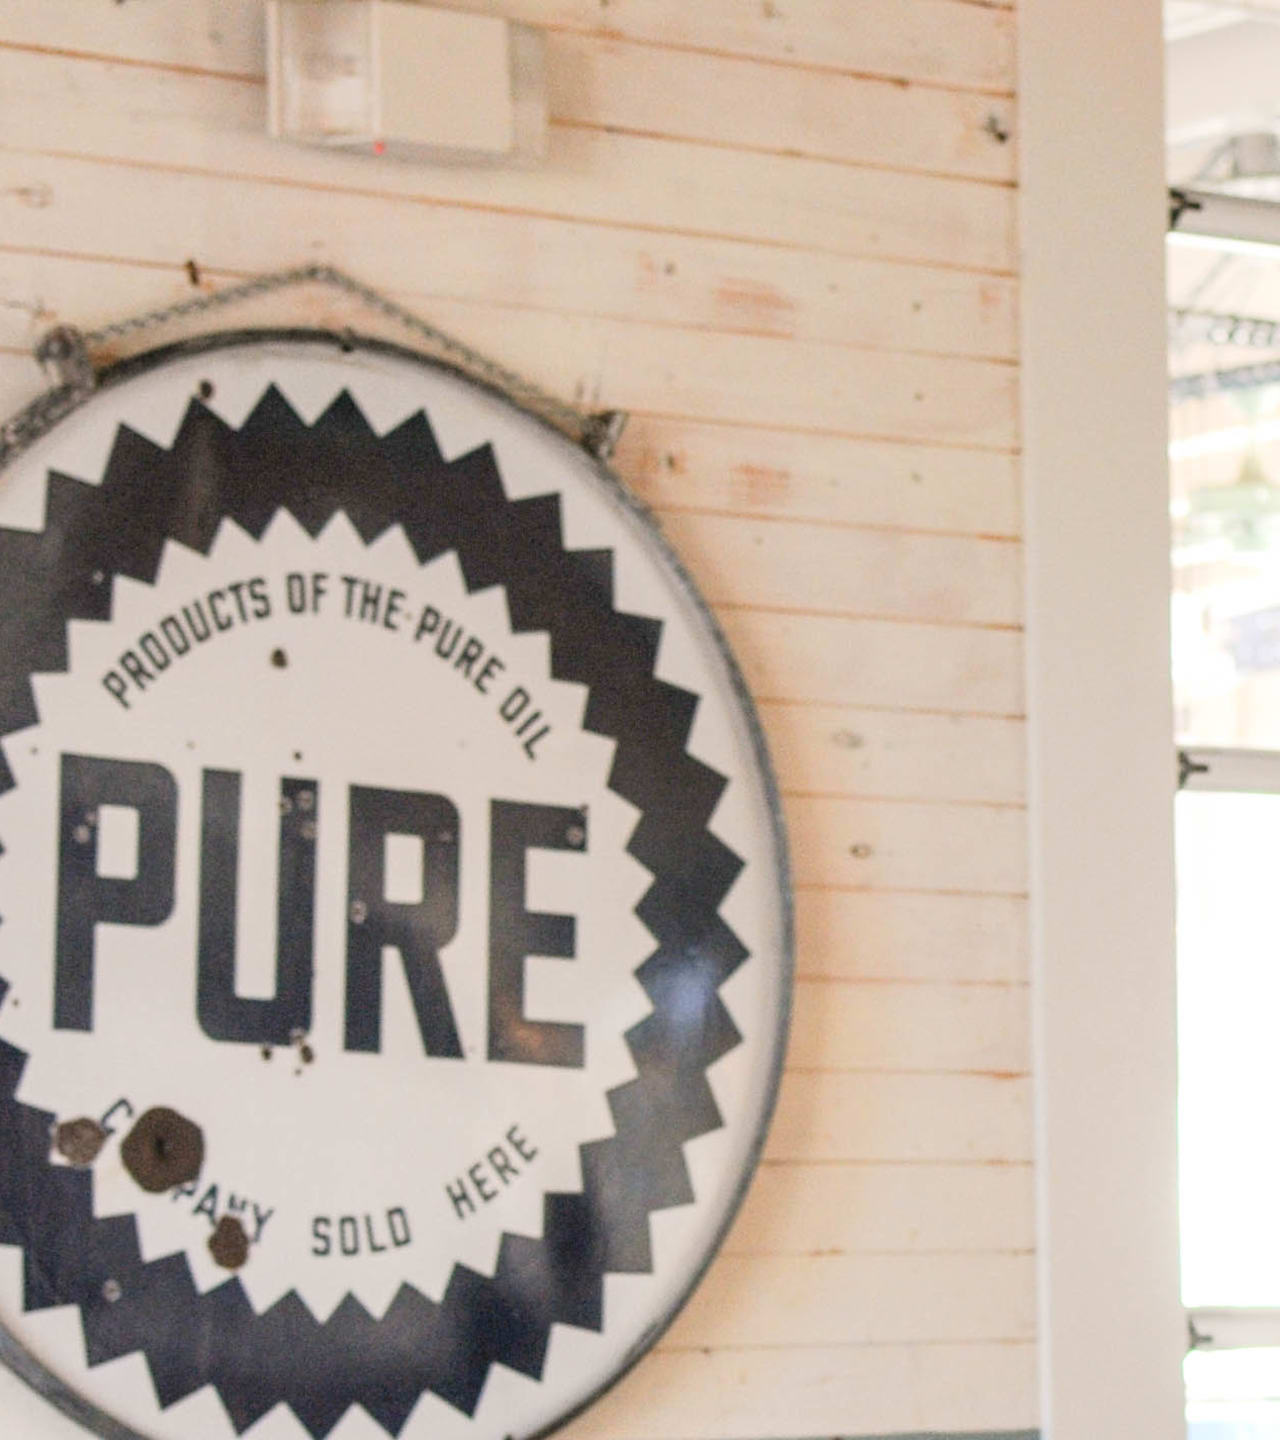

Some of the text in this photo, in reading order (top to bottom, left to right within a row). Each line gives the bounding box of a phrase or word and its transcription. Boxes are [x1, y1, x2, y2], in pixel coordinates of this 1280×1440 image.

[102, 572, 551, 760] PRODUCTS OF THE PURE OIL
[53, 752, 589, 1069] PURE
[312, 1207, 411, 1257] SOLD
[446, 1125, 538, 1219] HERE
